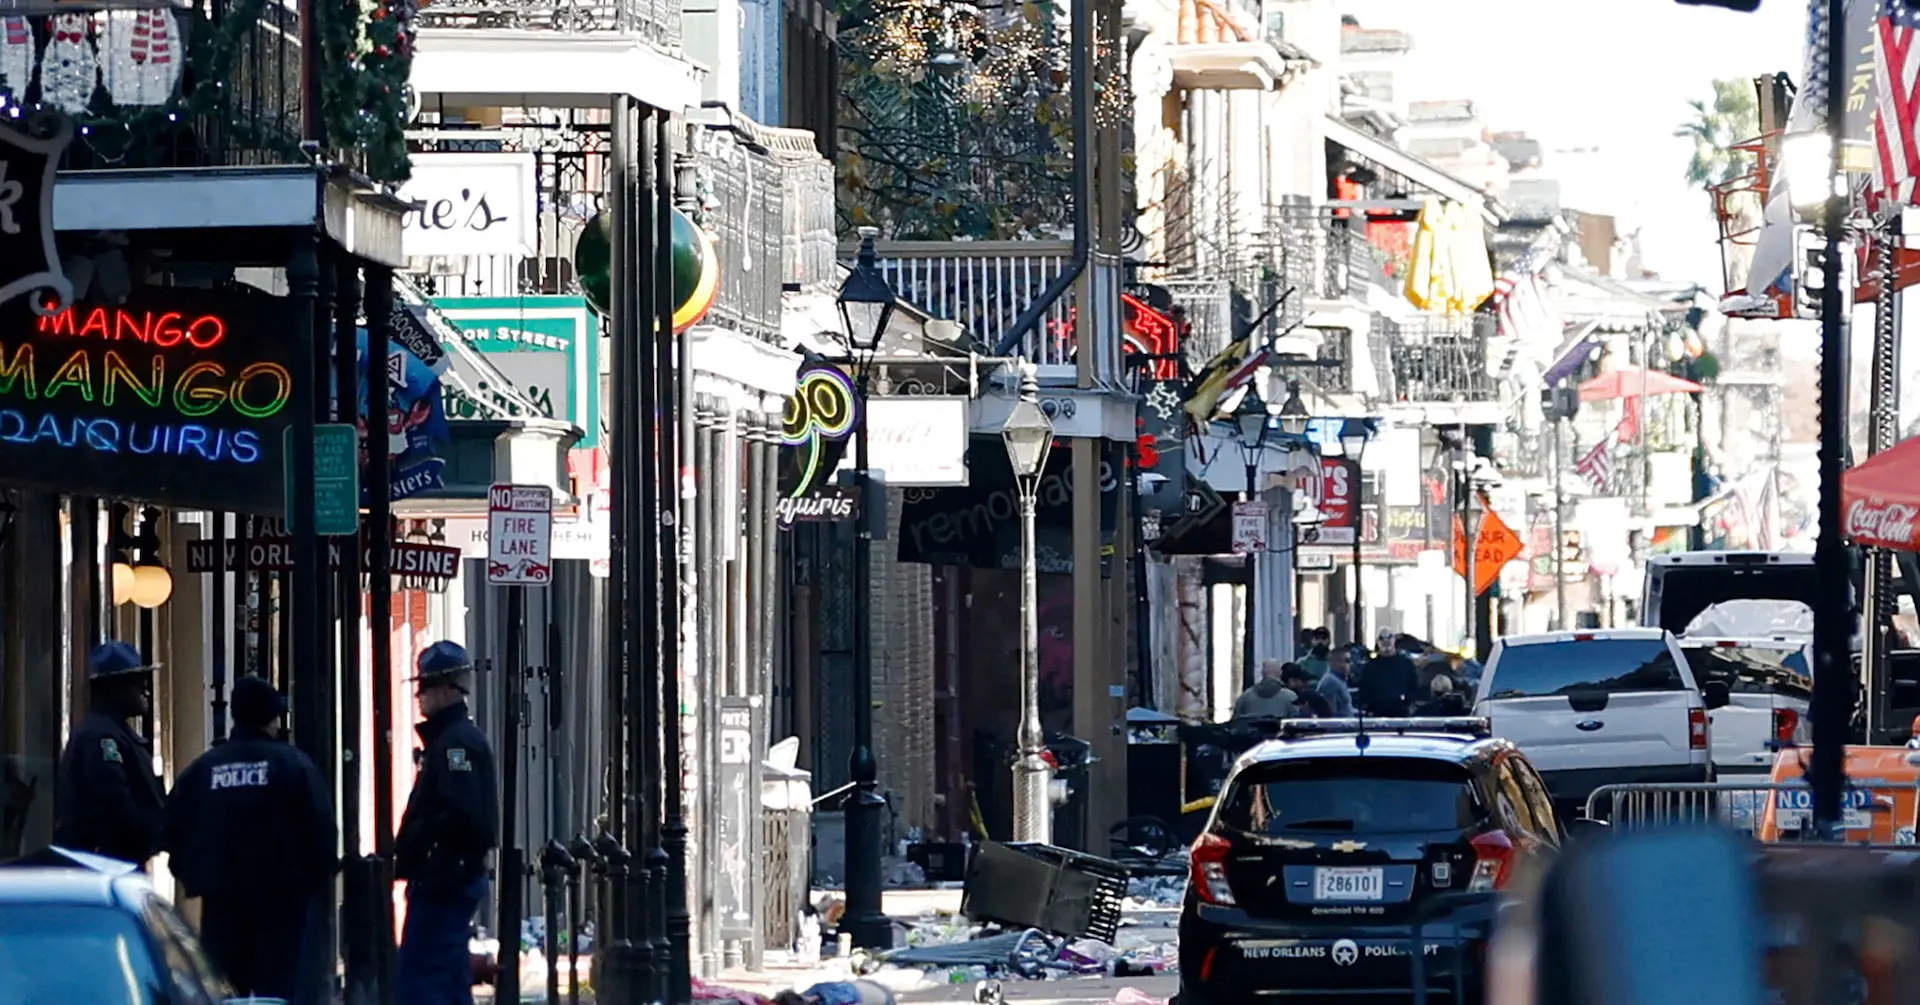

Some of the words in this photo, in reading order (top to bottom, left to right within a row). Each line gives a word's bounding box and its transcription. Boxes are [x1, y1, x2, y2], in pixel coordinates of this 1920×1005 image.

[402, 188, 508, 231] re's
[38, 301, 226, 348] MANGO
[0, 343, 291, 418] MANGO
[0, 409, 260, 463] DAIQUIRIS
[388, 469, 434, 498] sters
[491, 489, 511, 508] NO
[503, 517, 536, 533] FIRE
[1847, 499, 1918, 543] Coca-Cola
[500, 540, 538, 555] LANE
[211, 769, 268, 790] POLICE
[1327, 876, 1377, 892] 286101
[1243, 948, 1270, 958] NEW
[1271, 947, 1326, 958] ORLEANS
